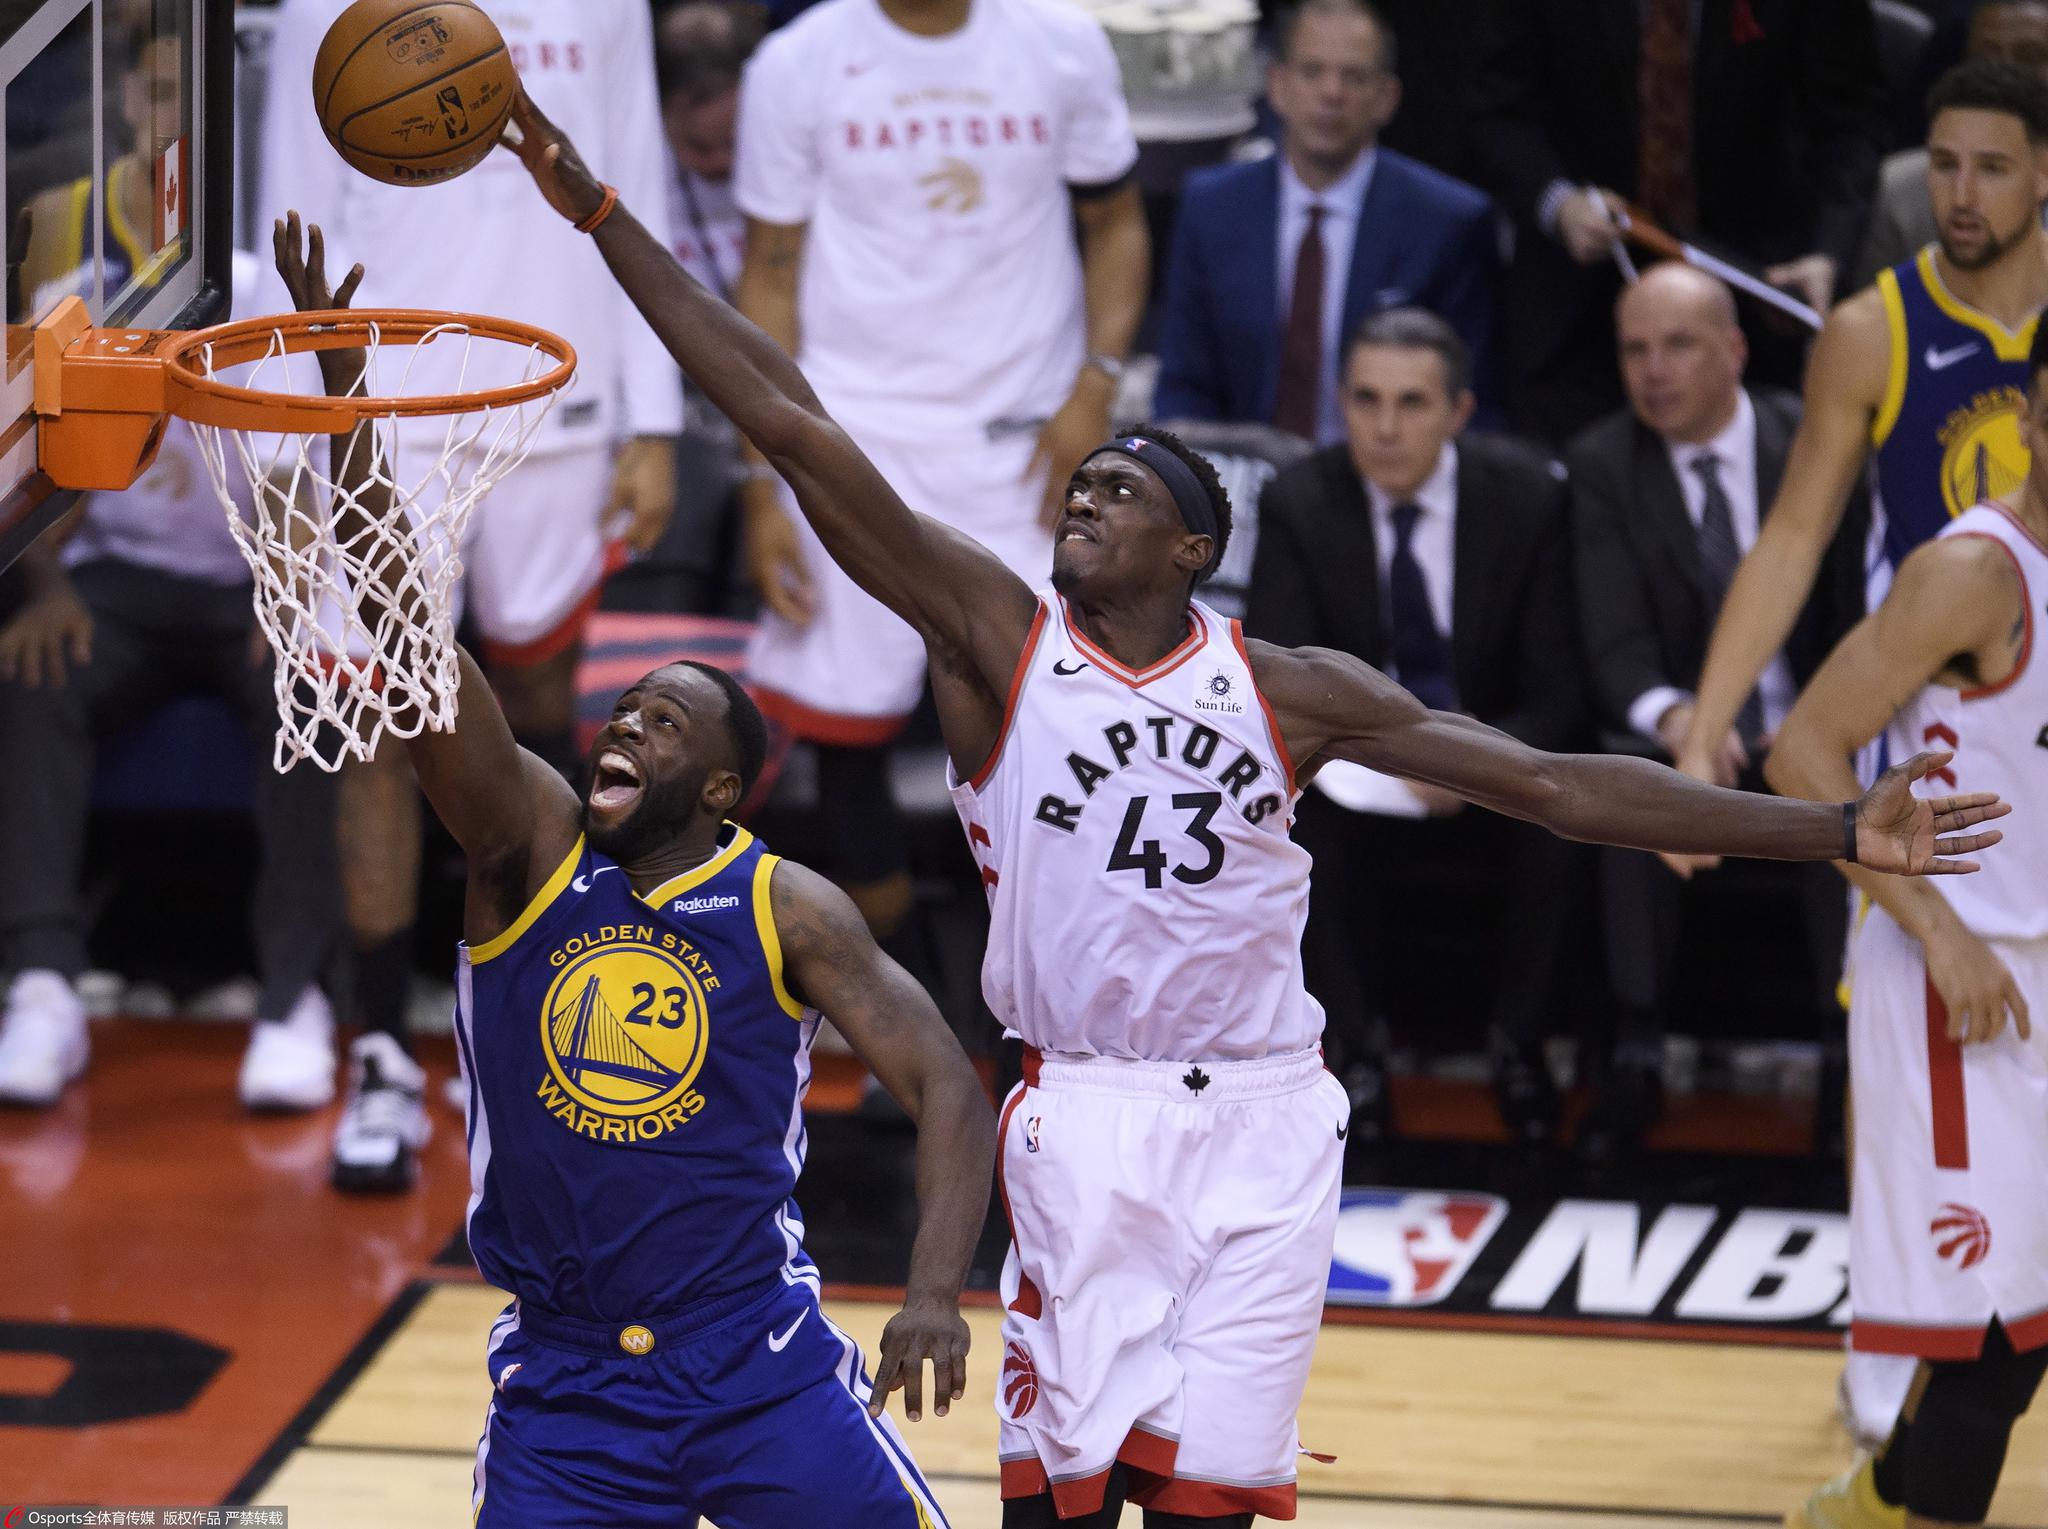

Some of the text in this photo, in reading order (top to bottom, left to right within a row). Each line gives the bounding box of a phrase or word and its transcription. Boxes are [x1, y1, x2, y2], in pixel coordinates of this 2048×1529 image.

[843, 115, 1050, 149] RAPTORS
[1194, 698, 1243, 714] Sun Life
[1033, 715, 1281, 835] RAPTORS
[1106, 791, 1225, 889] 43
[674, 895, 739, 914] Rakuten
[550, 924, 721, 993] GOLDEN STATE
[624, 981, 687, 1029] 23
[536, 1072, 706, 1143] WARRIORS
[1490, 1200, 1851, 1324] NB
